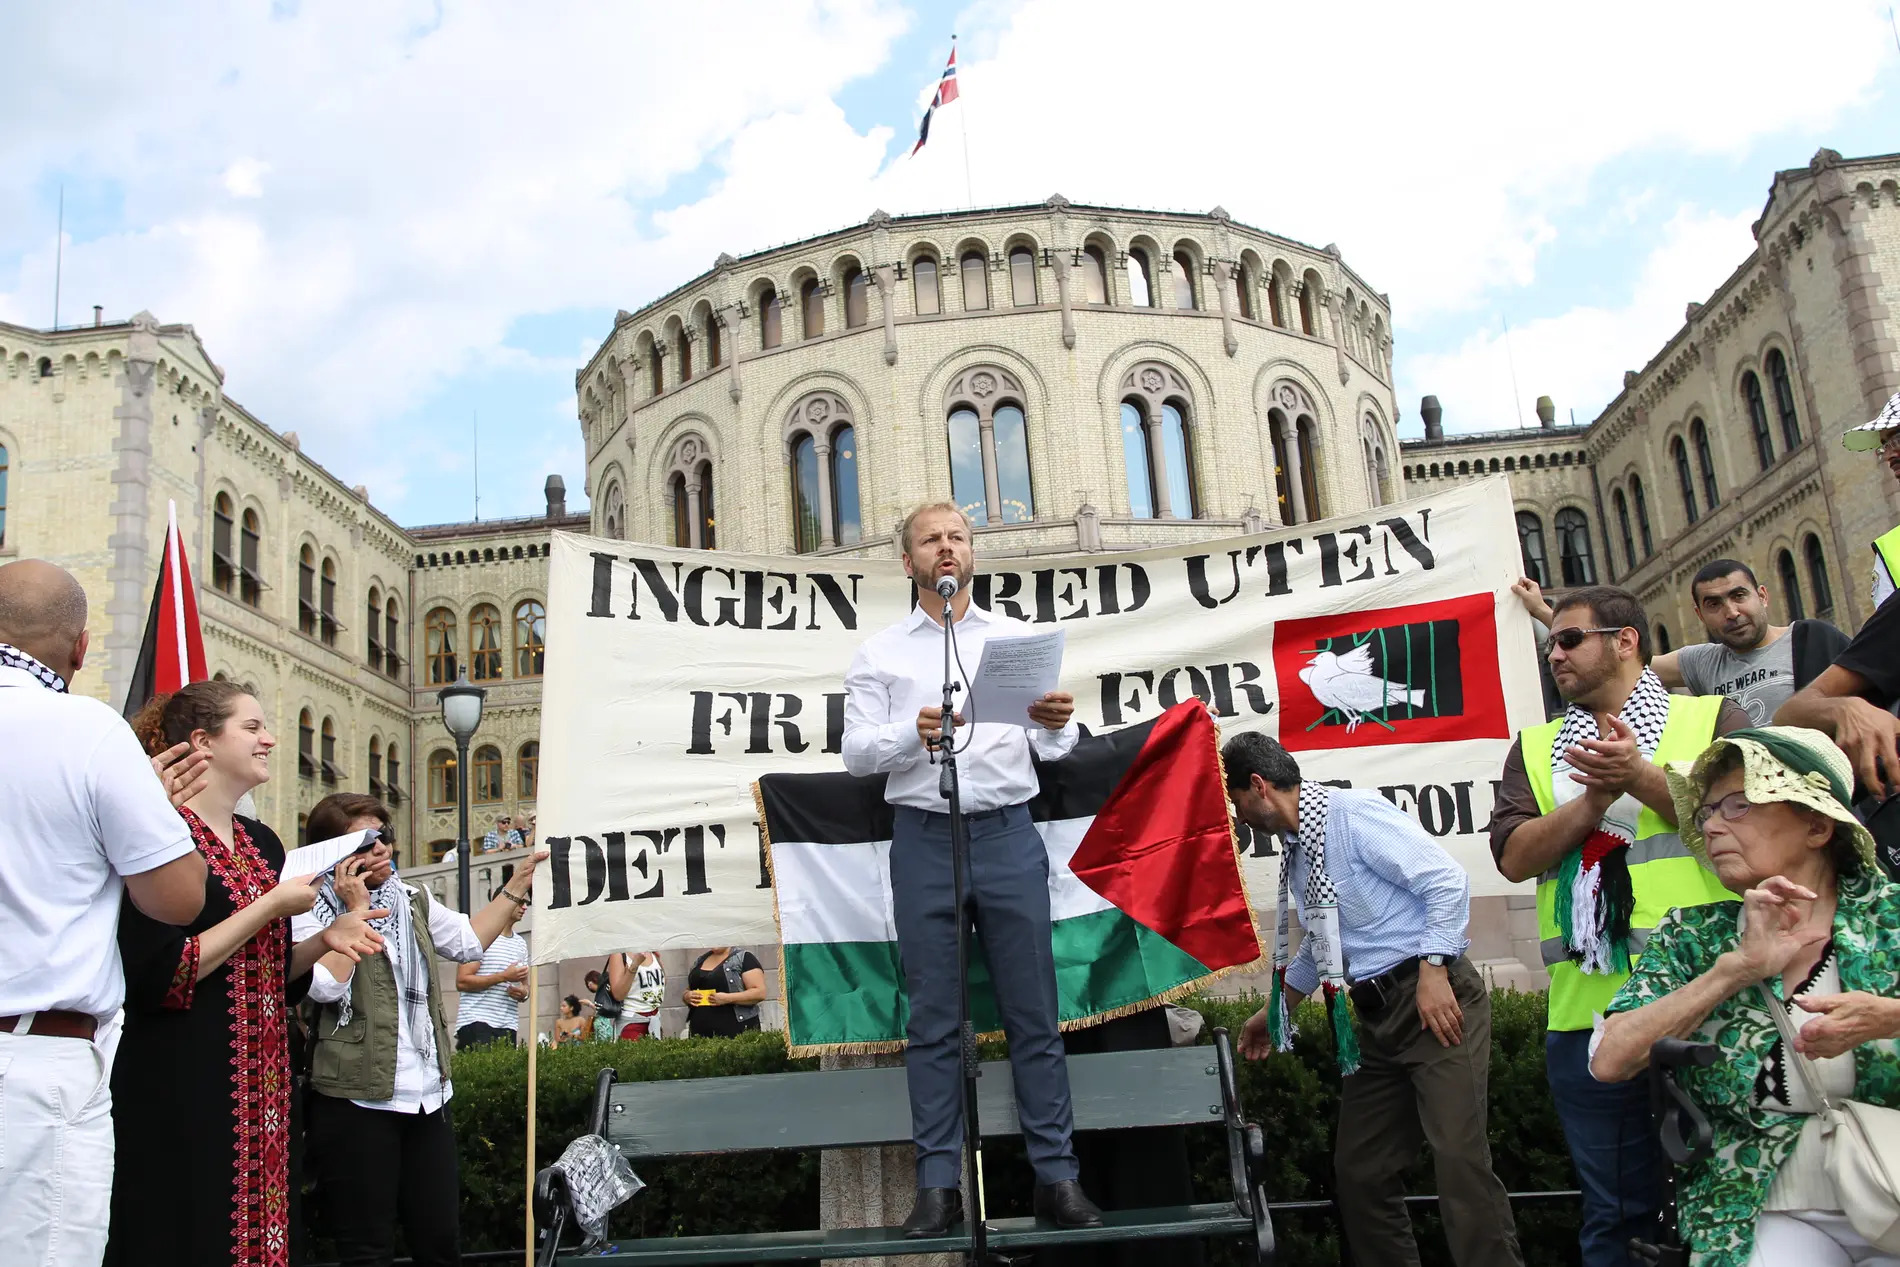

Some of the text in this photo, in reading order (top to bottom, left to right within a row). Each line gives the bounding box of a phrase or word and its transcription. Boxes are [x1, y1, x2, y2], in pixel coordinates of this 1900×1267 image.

[586, 508, 1436, 630] INGEN RED UTEN
[686, 690, 848, 754] FRI
[1096, 661, 1274, 728] FOR
[1735, 668, 1766, 690] WEAR
[545, 824, 726, 909] DET
